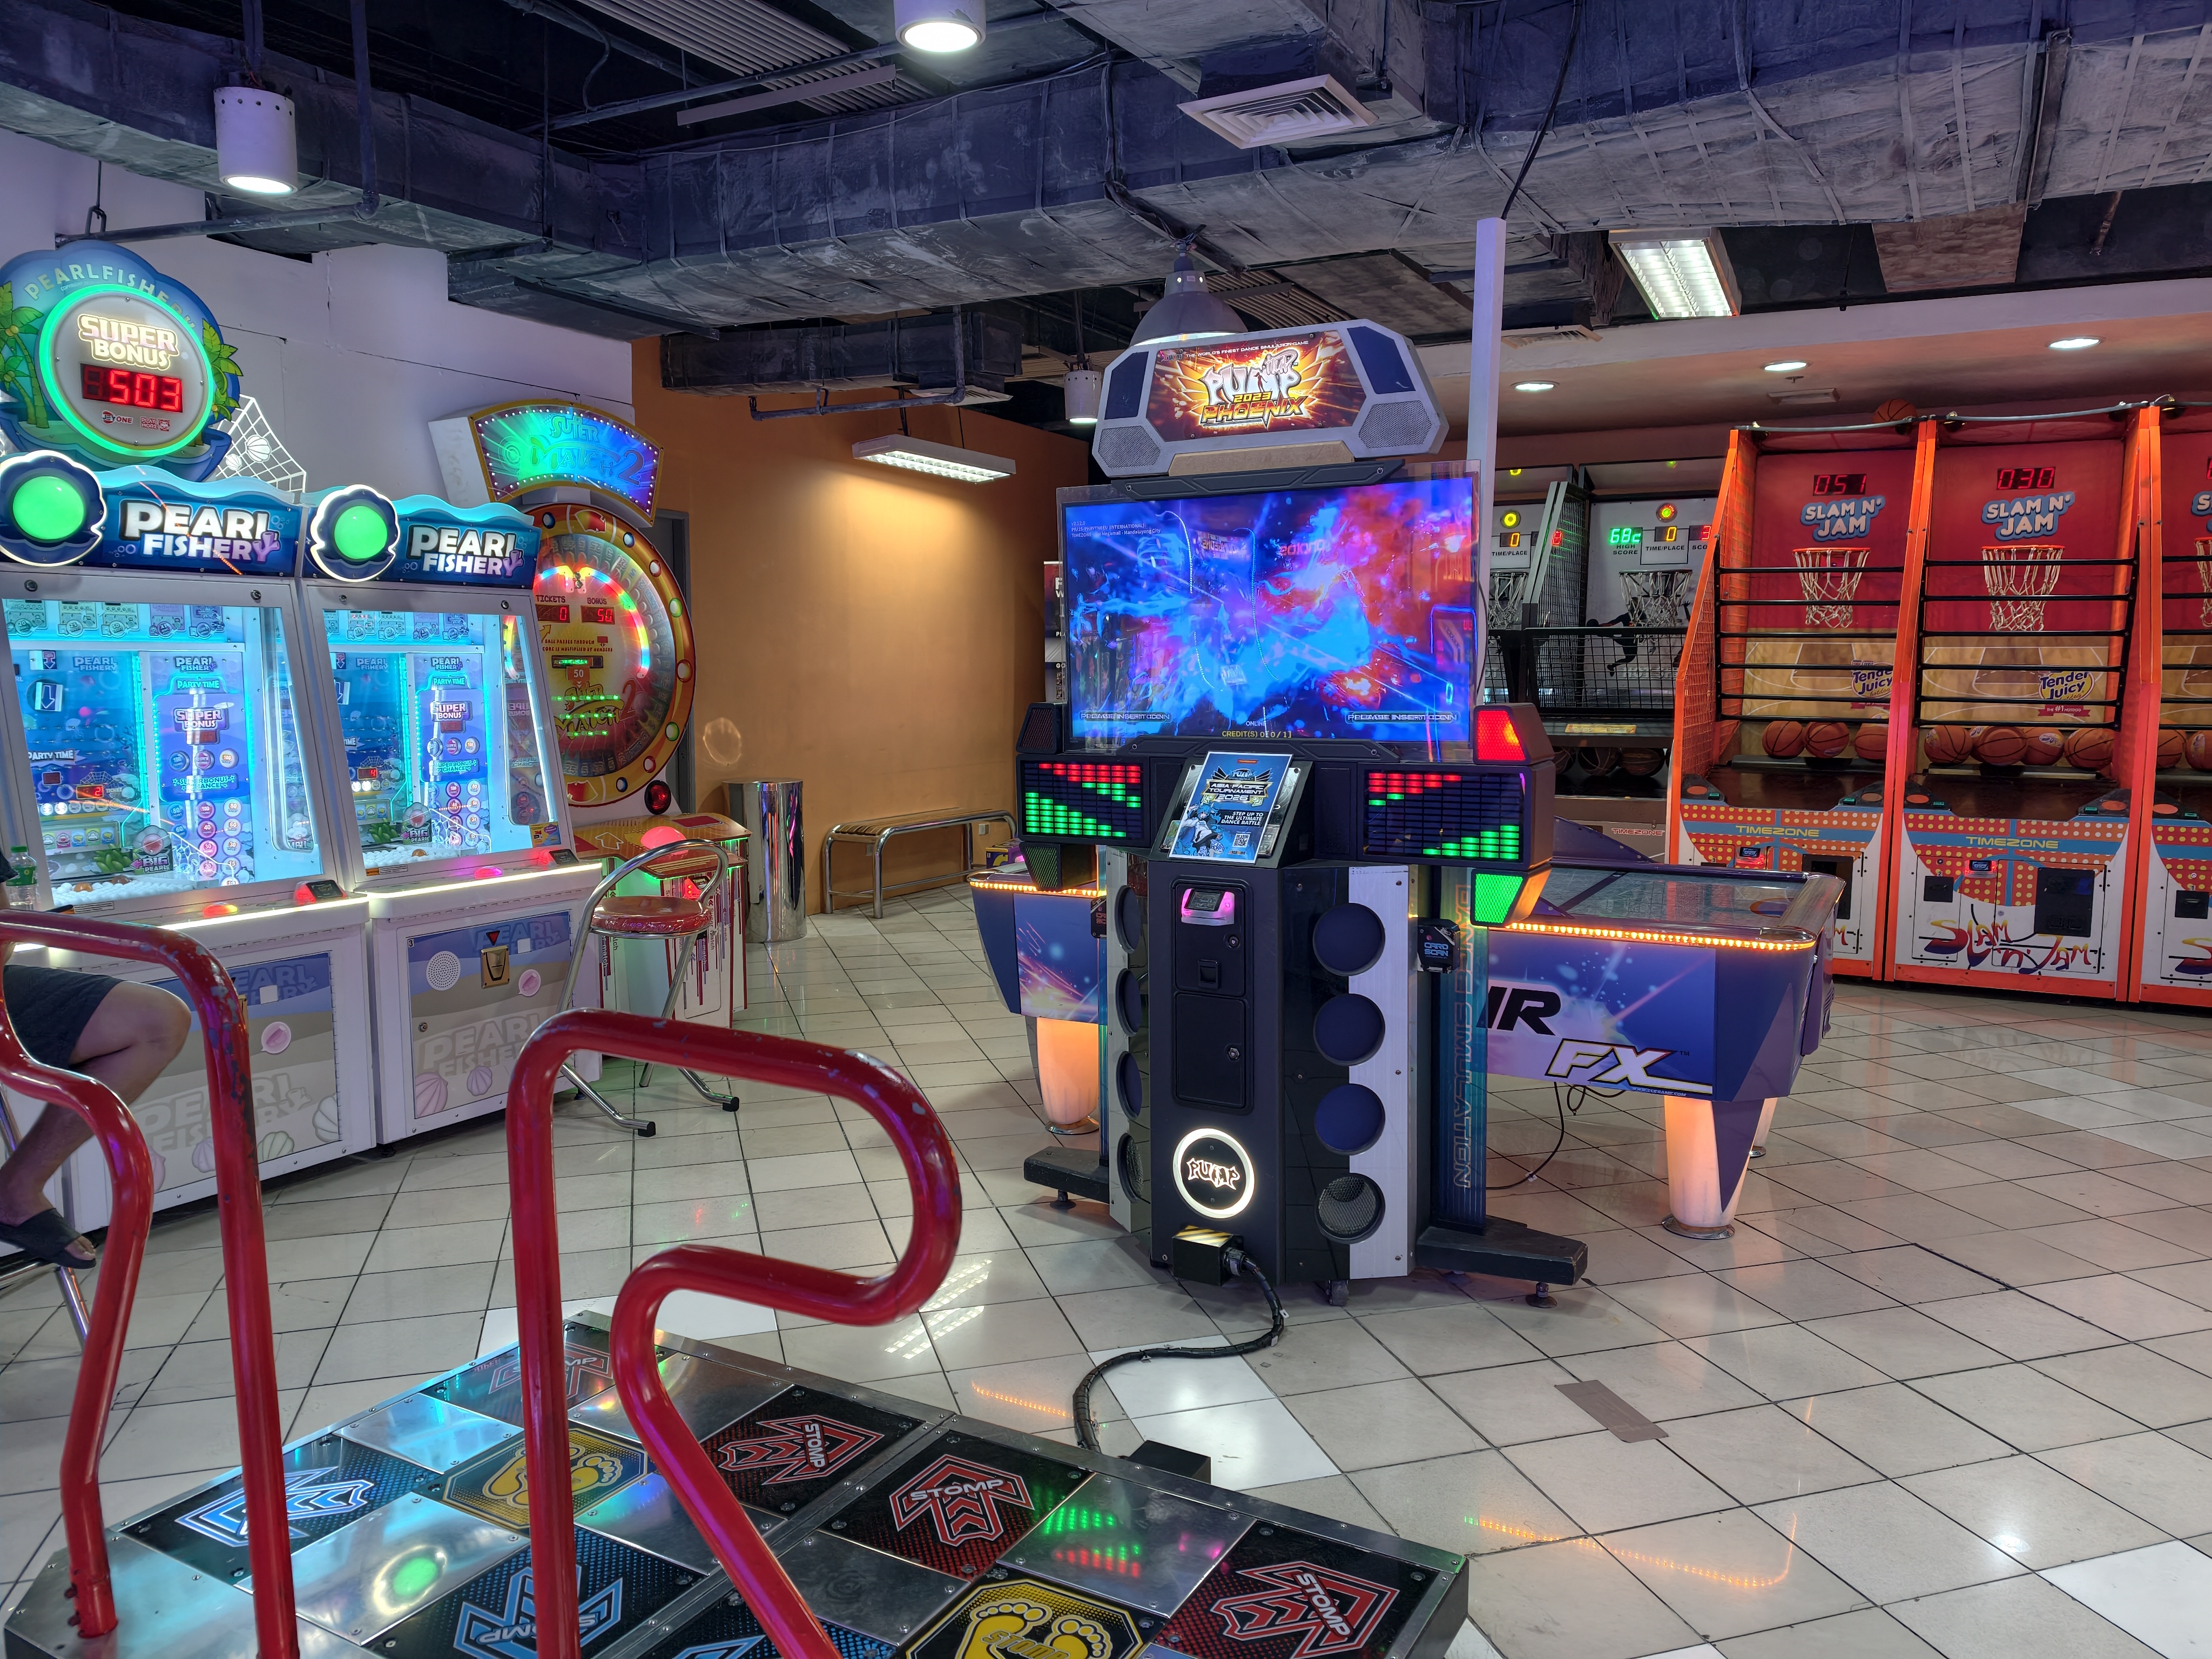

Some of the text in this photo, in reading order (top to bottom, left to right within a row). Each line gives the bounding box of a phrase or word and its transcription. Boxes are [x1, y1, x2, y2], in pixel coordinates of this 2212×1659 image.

[80, 316, 177, 353] SUPER
[95, 341, 169, 368] BONUS
[110, 369, 181, 411] 503
[1200, 363, 1301, 406] PUMP
[1233, 392, 1271, 402] 2023
[1201, 396, 1307, 425] PHOENIX
[530, 435, 644, 485] MATCH 2
[1815, 475, 1867, 495] 051
[1998, 467, 2055, 489] 030
[1805, 502, 1855, 521] SLAM
[1987, 499, 2041, 518] SLAM
[1666, 527, 1677, 542] 0
[1818, 516, 1866, 537] JAM
[2000, 514, 2053, 536] JAM
[142, 532, 281, 562] FISHERY
[1510, 532, 1520, 547] 0
[422, 550, 524, 577] FISHERY
[536, 595, 566, 603] TICKETS
[559, 607, 612, 622] 0 50
[75, 657, 117, 667] PEARL
[357, 658, 387, 666] PEARL
[177, 680, 220, 689] PARTY TIME
[2040, 671, 2089, 690] Tender
[2049, 681, 2085, 699] Juicy
[433, 703, 467, 712] SUPER
[622, 678, 637, 721] 2
[343, 737, 356, 745] TIME
[55, 749, 73, 759] TIME
[409, 829, 428, 839] BIG
[1611, 828, 1664, 836] TIMEZONE
[1736, 825, 1819, 837] TIMEZONE
[1966, 837, 2059, 848] TIMEZONE
[143, 857, 168, 867] BIG
[1424, 942, 1449, 950] CARD
[1424, 948, 1448, 957] SCAN
[1546, 1038, 1681, 1087] FX
[1454, 1002, 1473, 1187] SIMULATION
[1186, 1157, 1240, 1190] PUMP
[804, 1422, 826, 1469] STOMP
[909, 1479, 1005, 1502] STOMP
[1296, 1573, 1352, 1637] STOMP
